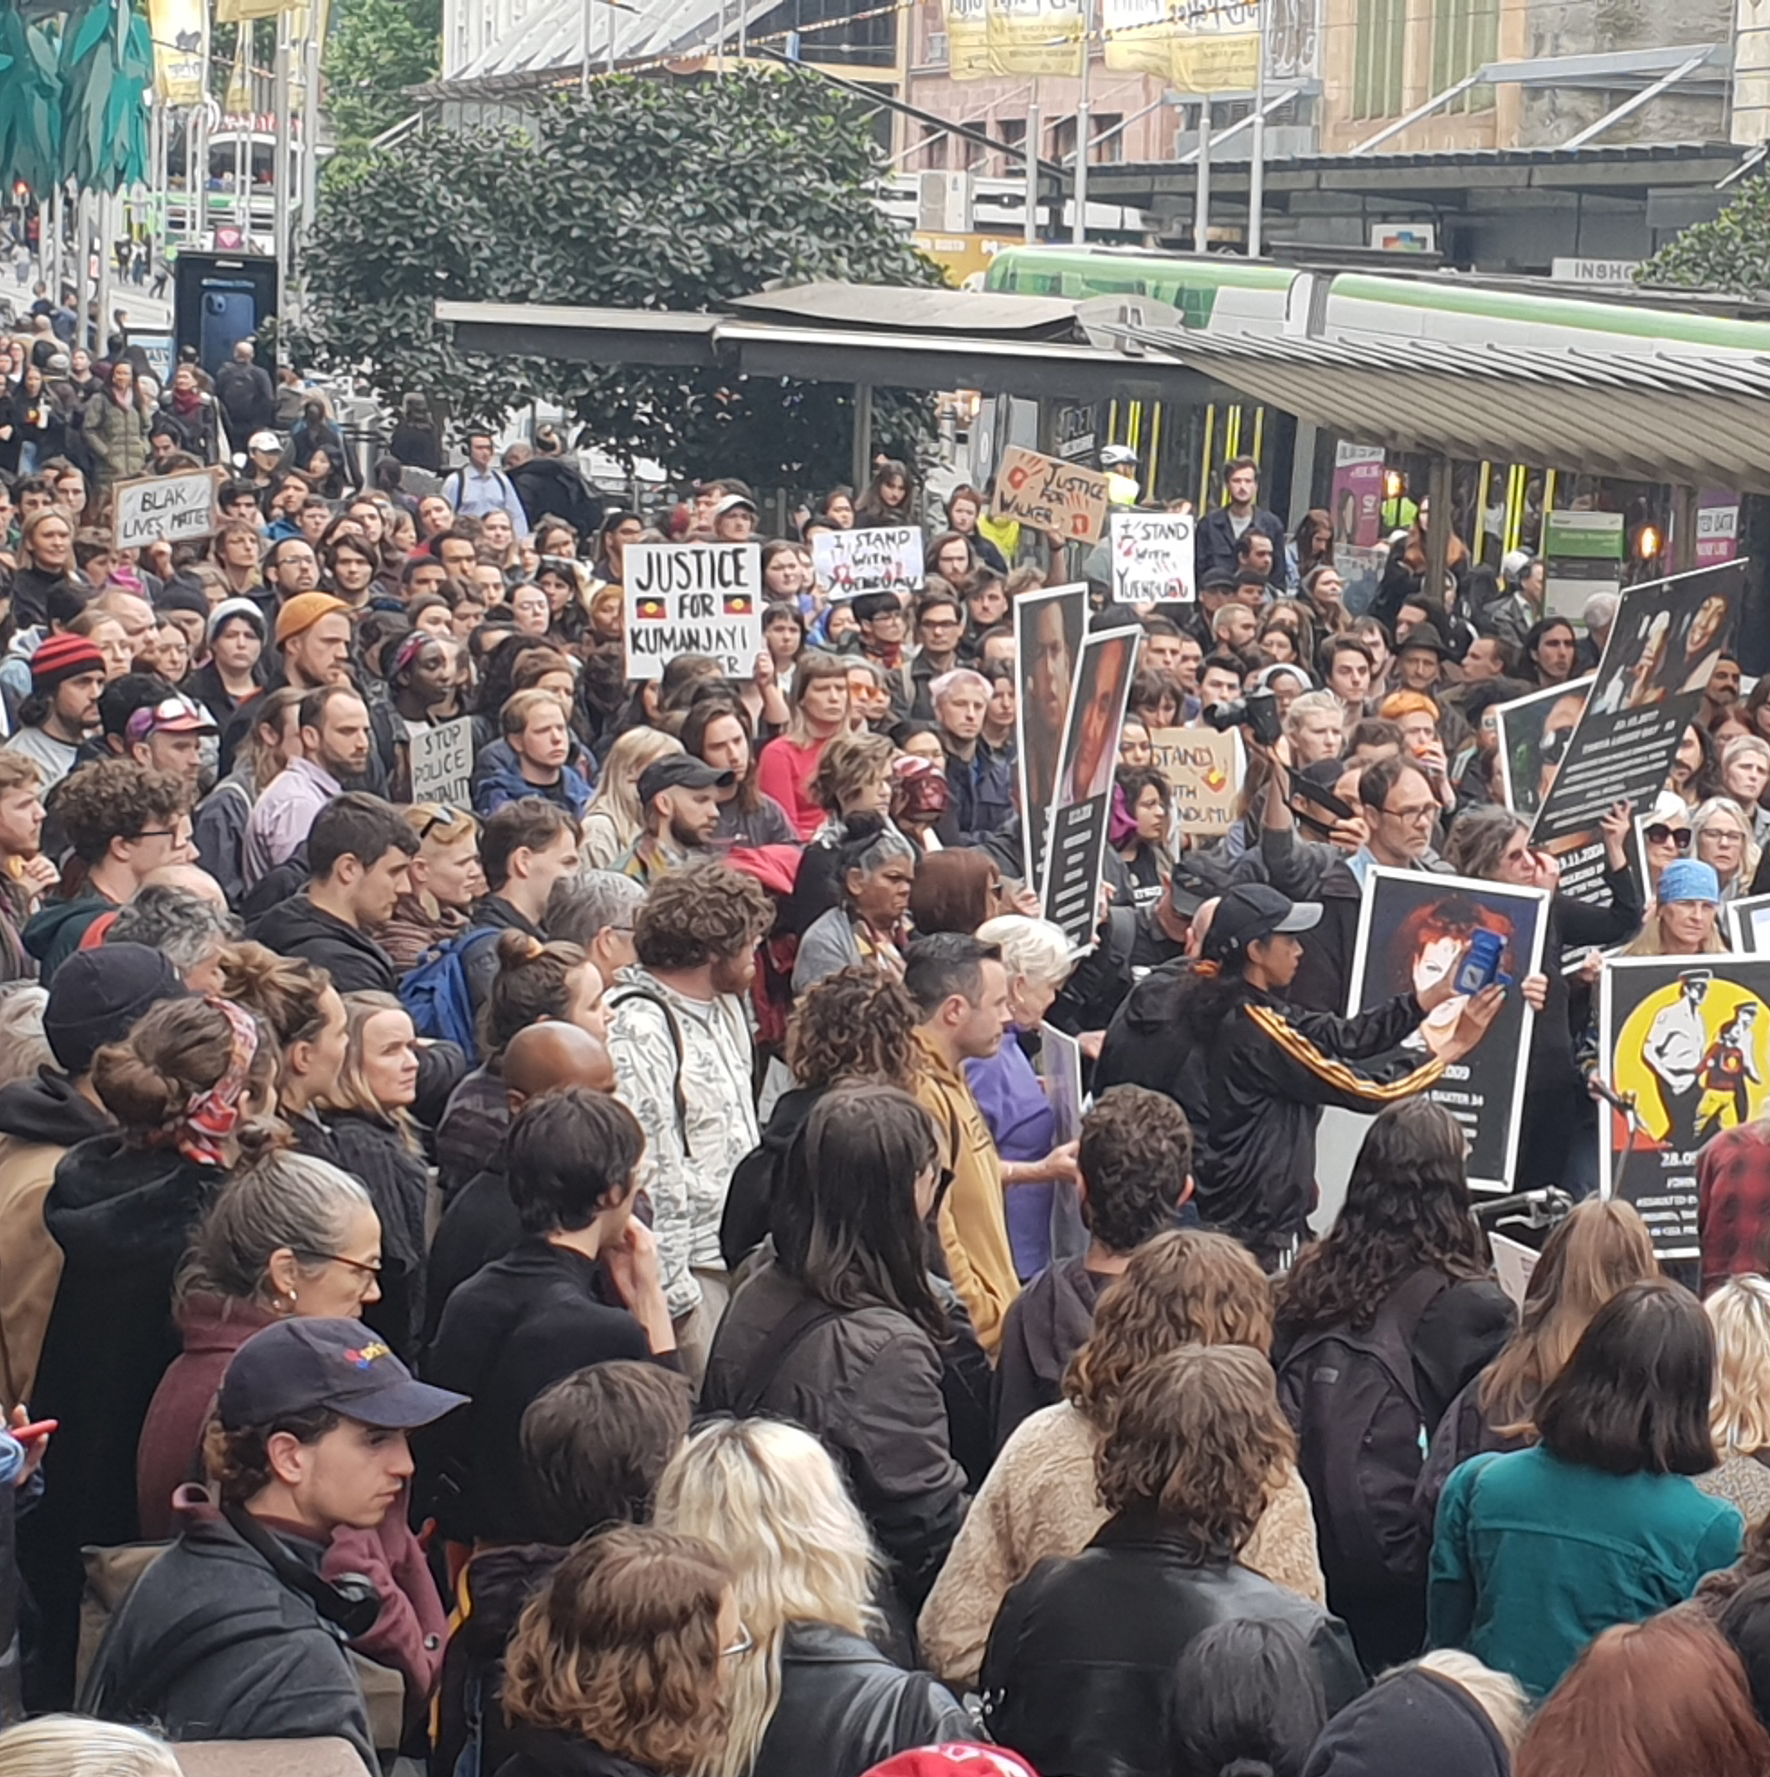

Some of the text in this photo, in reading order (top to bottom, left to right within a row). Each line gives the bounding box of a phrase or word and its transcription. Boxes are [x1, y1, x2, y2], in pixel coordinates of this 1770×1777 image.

[1043, 462, 1106, 501] JUSTICE
[140, 487, 187, 513] BLAK
[1000, 490, 1053, 524] WALKER
[123, 515, 163, 540] LIVES
[833, 529, 911, 548] I STAND
[1140, 521, 1190, 541] STAND
[852, 553, 893, 567] WITH
[1135, 547, 1171, 560] WITH
[635, 547, 750, 593] JUSTICE
[678, 592, 715, 620] FOR
[630, 625, 748, 655] KUMANJAYI
[425, 723, 461, 756] STOP
[414, 748, 467, 787] POLICE
[1173, 784, 1198, 799] ITH
